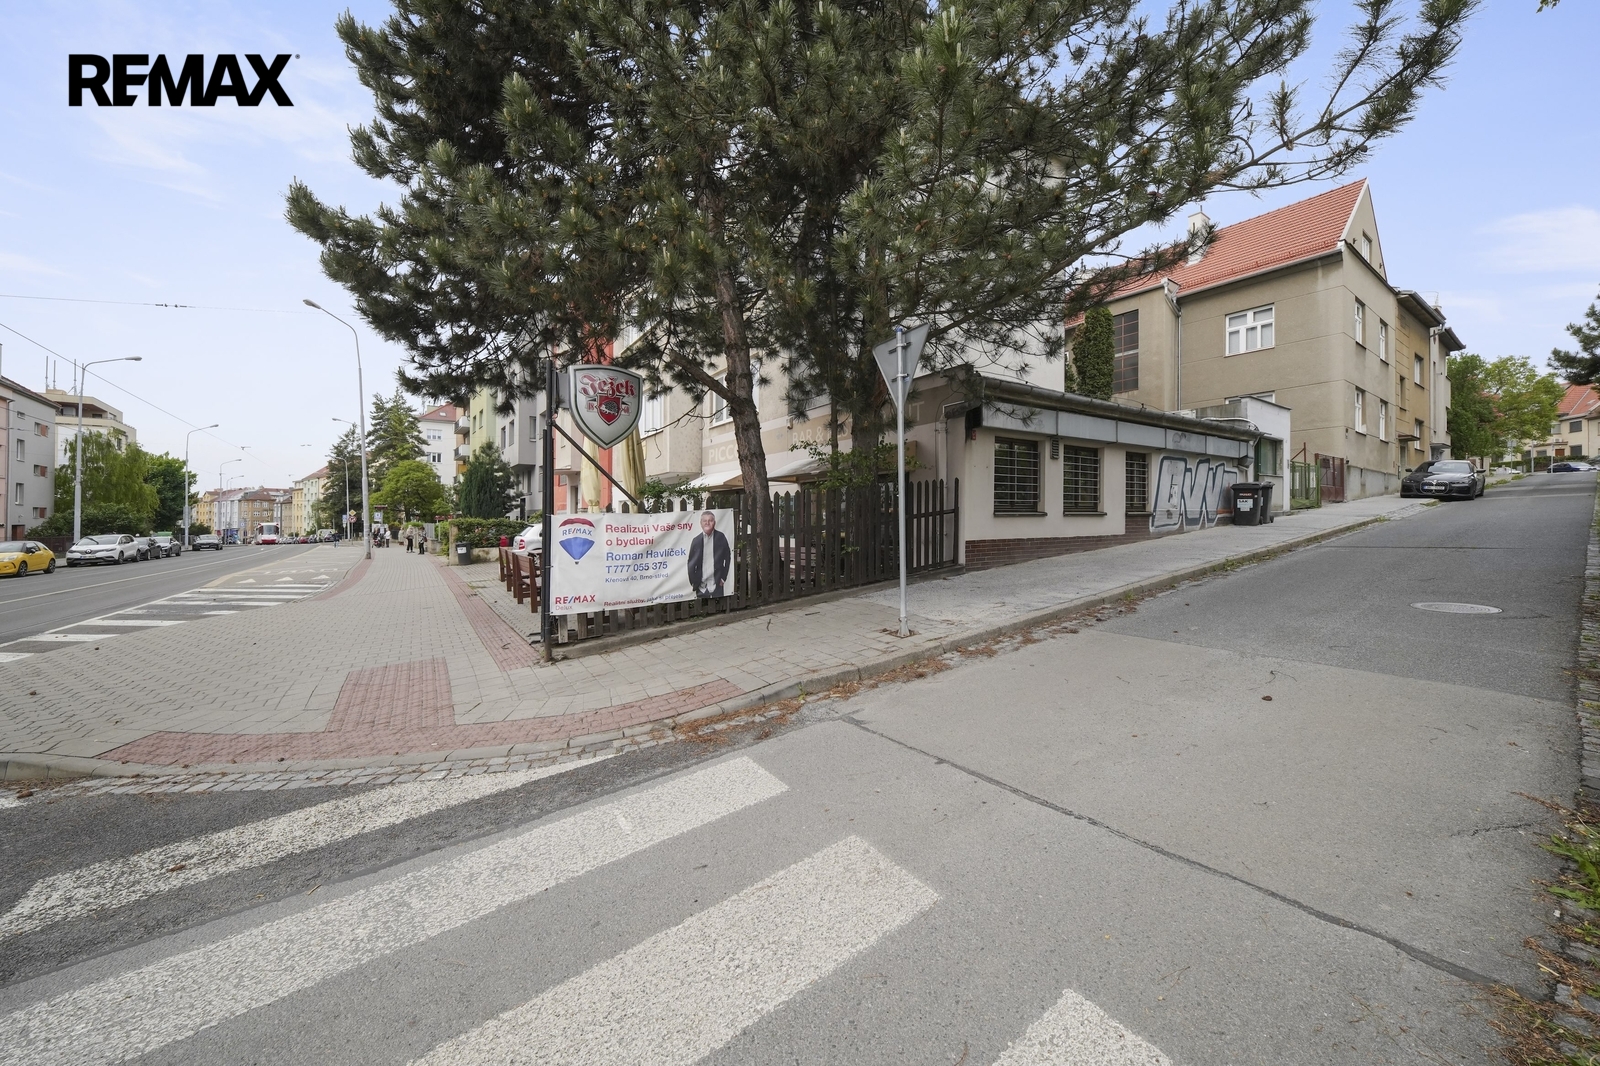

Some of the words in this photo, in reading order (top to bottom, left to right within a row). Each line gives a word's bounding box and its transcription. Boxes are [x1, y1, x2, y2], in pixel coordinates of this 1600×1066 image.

[579, 374, 635, 397] Ježek
[792, 429, 813, 447] BAR
[815, 426, 824, 442] &
[562, 527, 593, 536] RE/MAX
[605, 524, 650, 535] Realizuji
[652, 522, 676, 532] Vaše
[677, 522, 693, 532] sny
[615, 536, 655, 548] bydlení
[606, 552, 643, 562] Roman
[645, 547, 687, 559] Havlíček
[633, 562, 649, 572] 055
[651, 561, 668, 570] 375
[555, 594, 596, 604] RE/MAX
